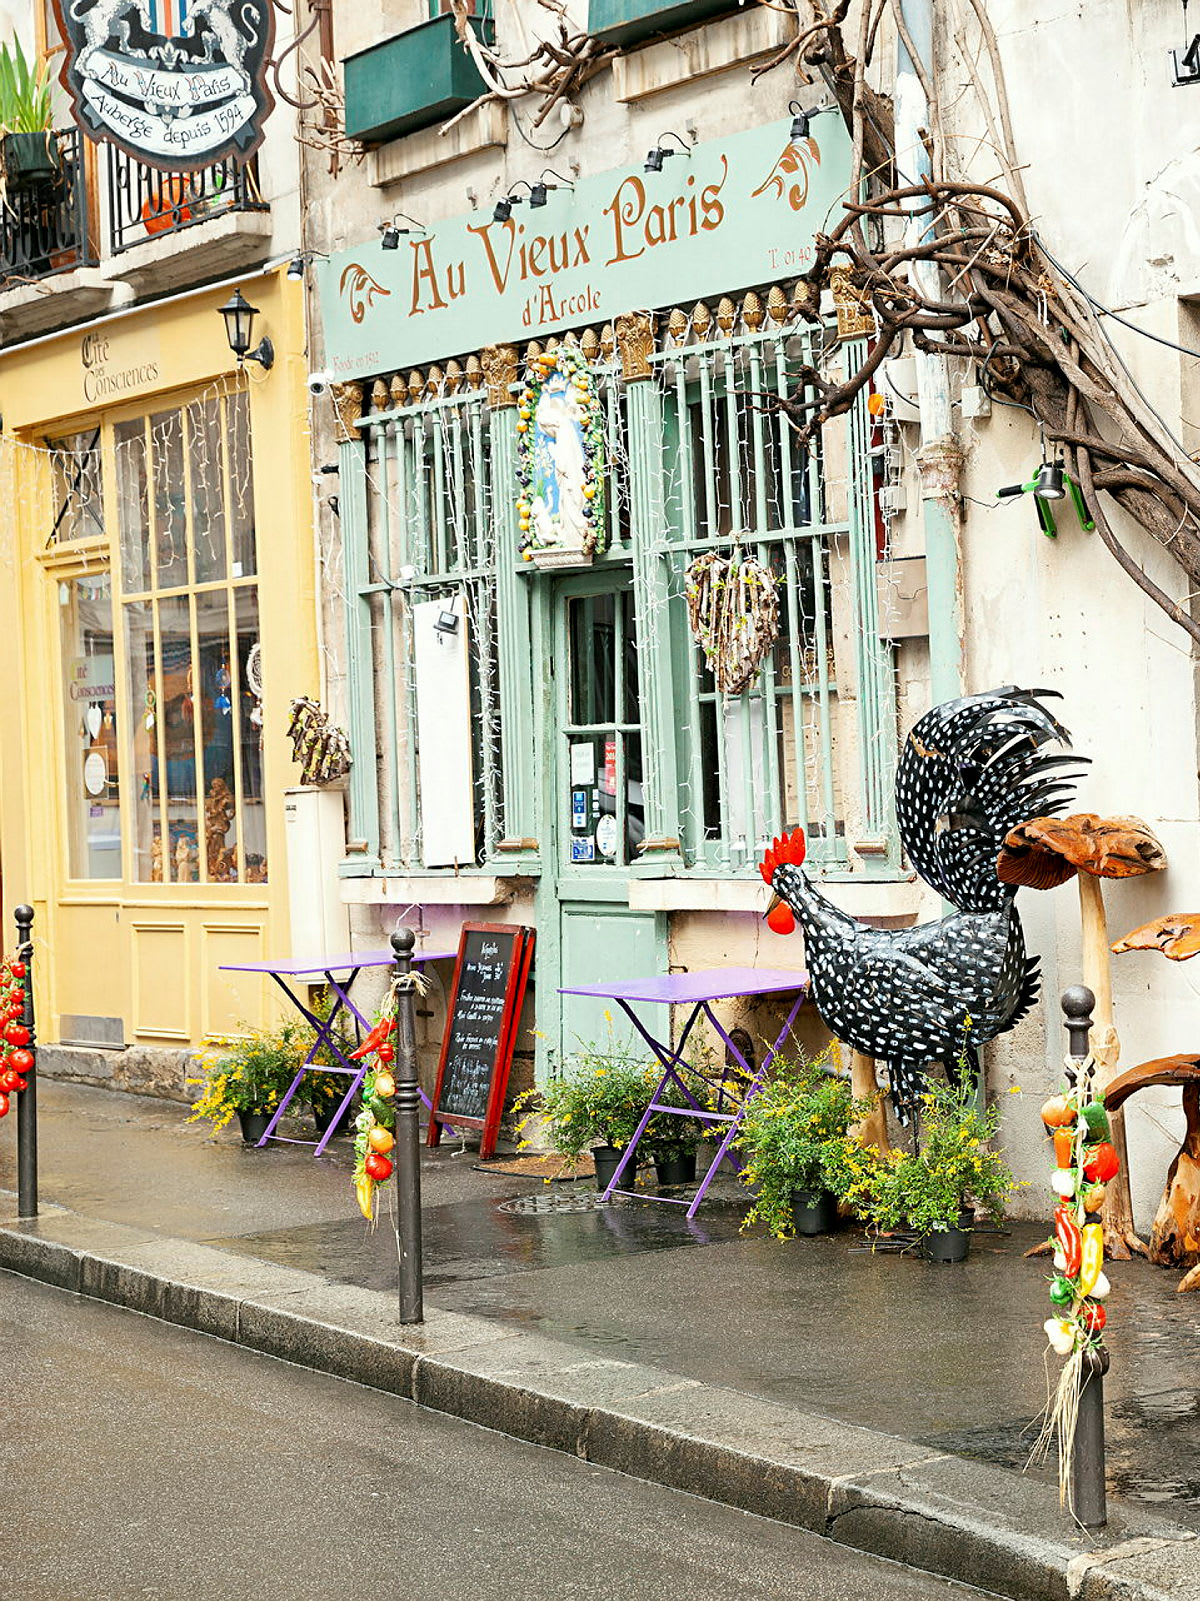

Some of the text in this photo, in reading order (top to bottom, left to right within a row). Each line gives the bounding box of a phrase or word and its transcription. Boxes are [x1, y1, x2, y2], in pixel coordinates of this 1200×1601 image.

[101, 61, 232, 102] Au Vieux Paris
[90, 95, 244, 150] Auberge depuis 1594
[408, 153, 729, 317] Au Vieux Paris
[522, 282, 602, 327] d'Arcole
[83, 361, 159, 403] Consciences
